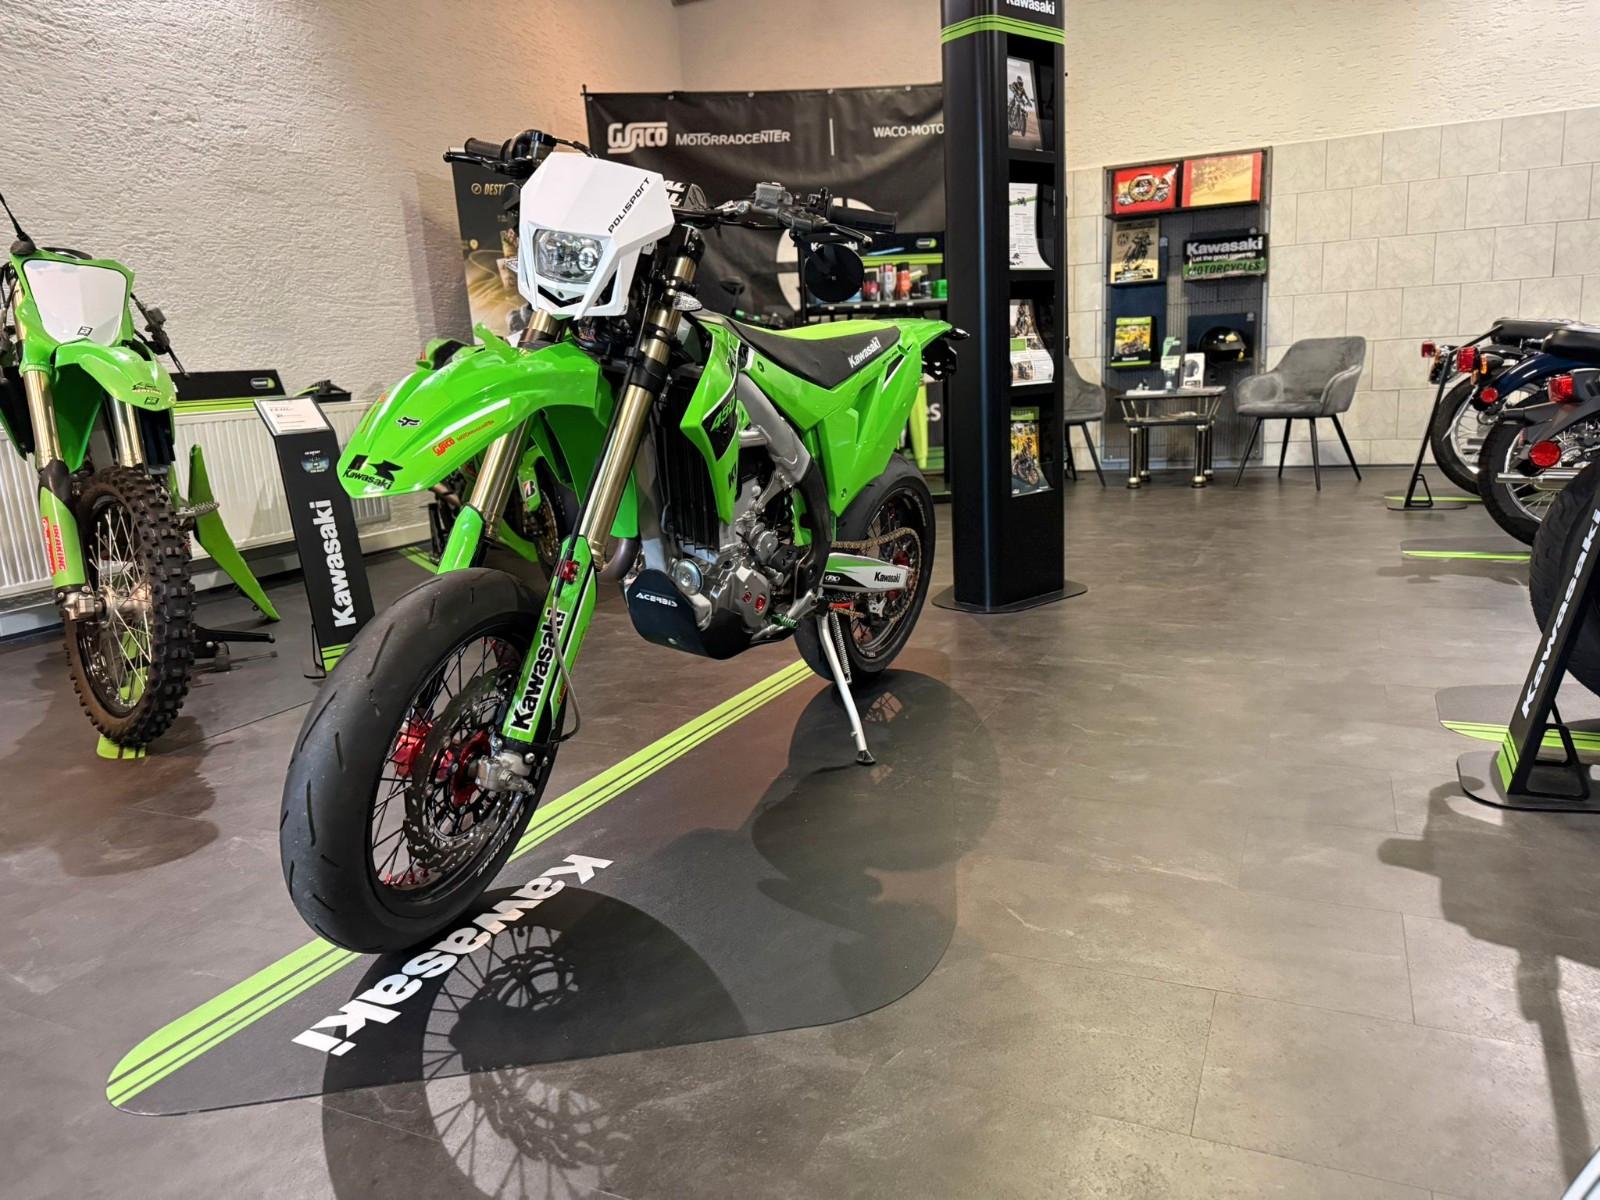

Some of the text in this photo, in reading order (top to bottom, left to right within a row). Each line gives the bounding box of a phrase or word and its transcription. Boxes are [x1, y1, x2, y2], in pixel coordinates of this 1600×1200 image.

[675, 129, 791, 146] MOTORRADCENTER
[608, 176, 650, 234] POLISPORT
[1186, 236, 1263, 255] Kawasaki
[848, 336, 881, 368] Kawasaki
[343, 468, 394, 490] Kawasaki
[309, 499, 357, 628] Kawasaki
[874, 571, 901, 583] Kawasaki
[635, 592, 679, 608] ACERBIS
[1521, 508, 1600, 719] Kawasaki
[510, 608, 567, 732] Kawasaki
[291, 854, 614, 1057] Kawasaki
